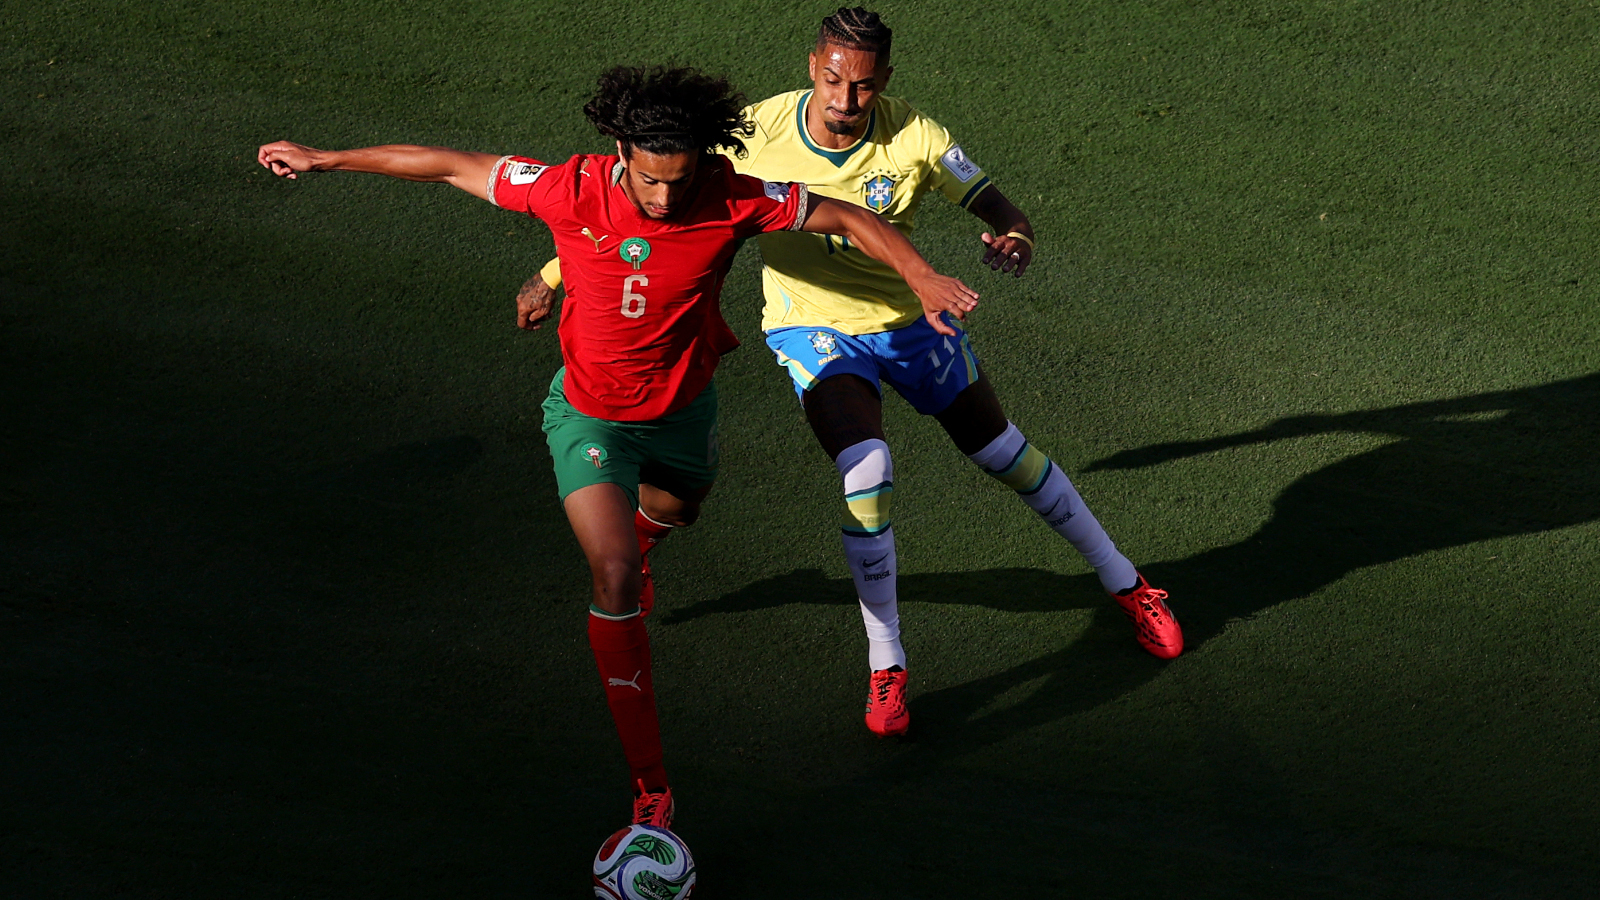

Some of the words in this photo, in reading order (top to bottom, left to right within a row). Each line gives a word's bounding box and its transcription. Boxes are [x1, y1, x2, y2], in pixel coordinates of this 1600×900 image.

[620, 274, 649, 319] 6
[927, 335, 956, 369] 11
[1050, 511, 1077, 527] BRASIL
[864, 569, 892, 582] BRASIL
